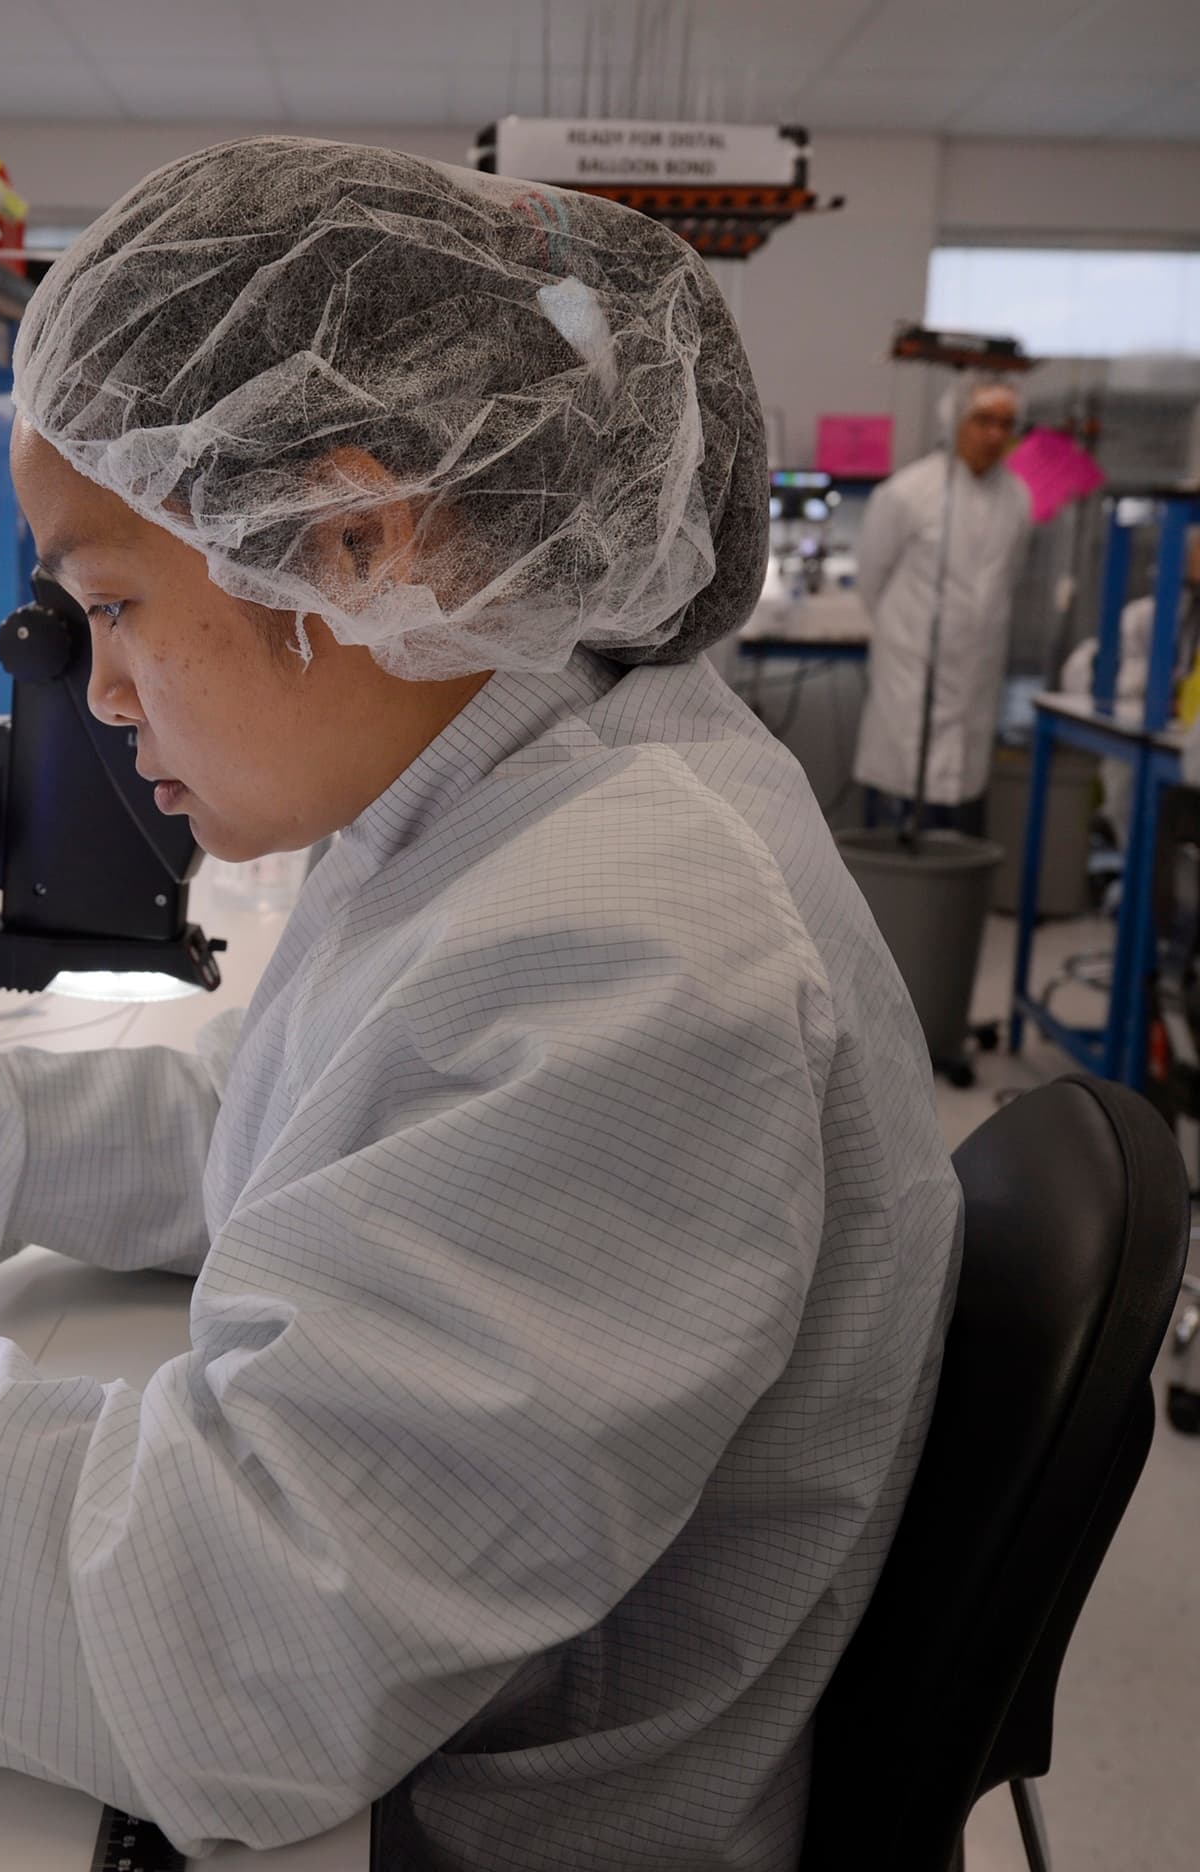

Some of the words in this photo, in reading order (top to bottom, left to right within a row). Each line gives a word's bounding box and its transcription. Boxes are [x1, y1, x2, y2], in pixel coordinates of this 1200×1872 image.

[567, 129, 623, 145] READY
[628, 131, 662, 146] FOR
[576, 156, 659, 174] BALLOON
[664, 158, 716, 175] BOND
